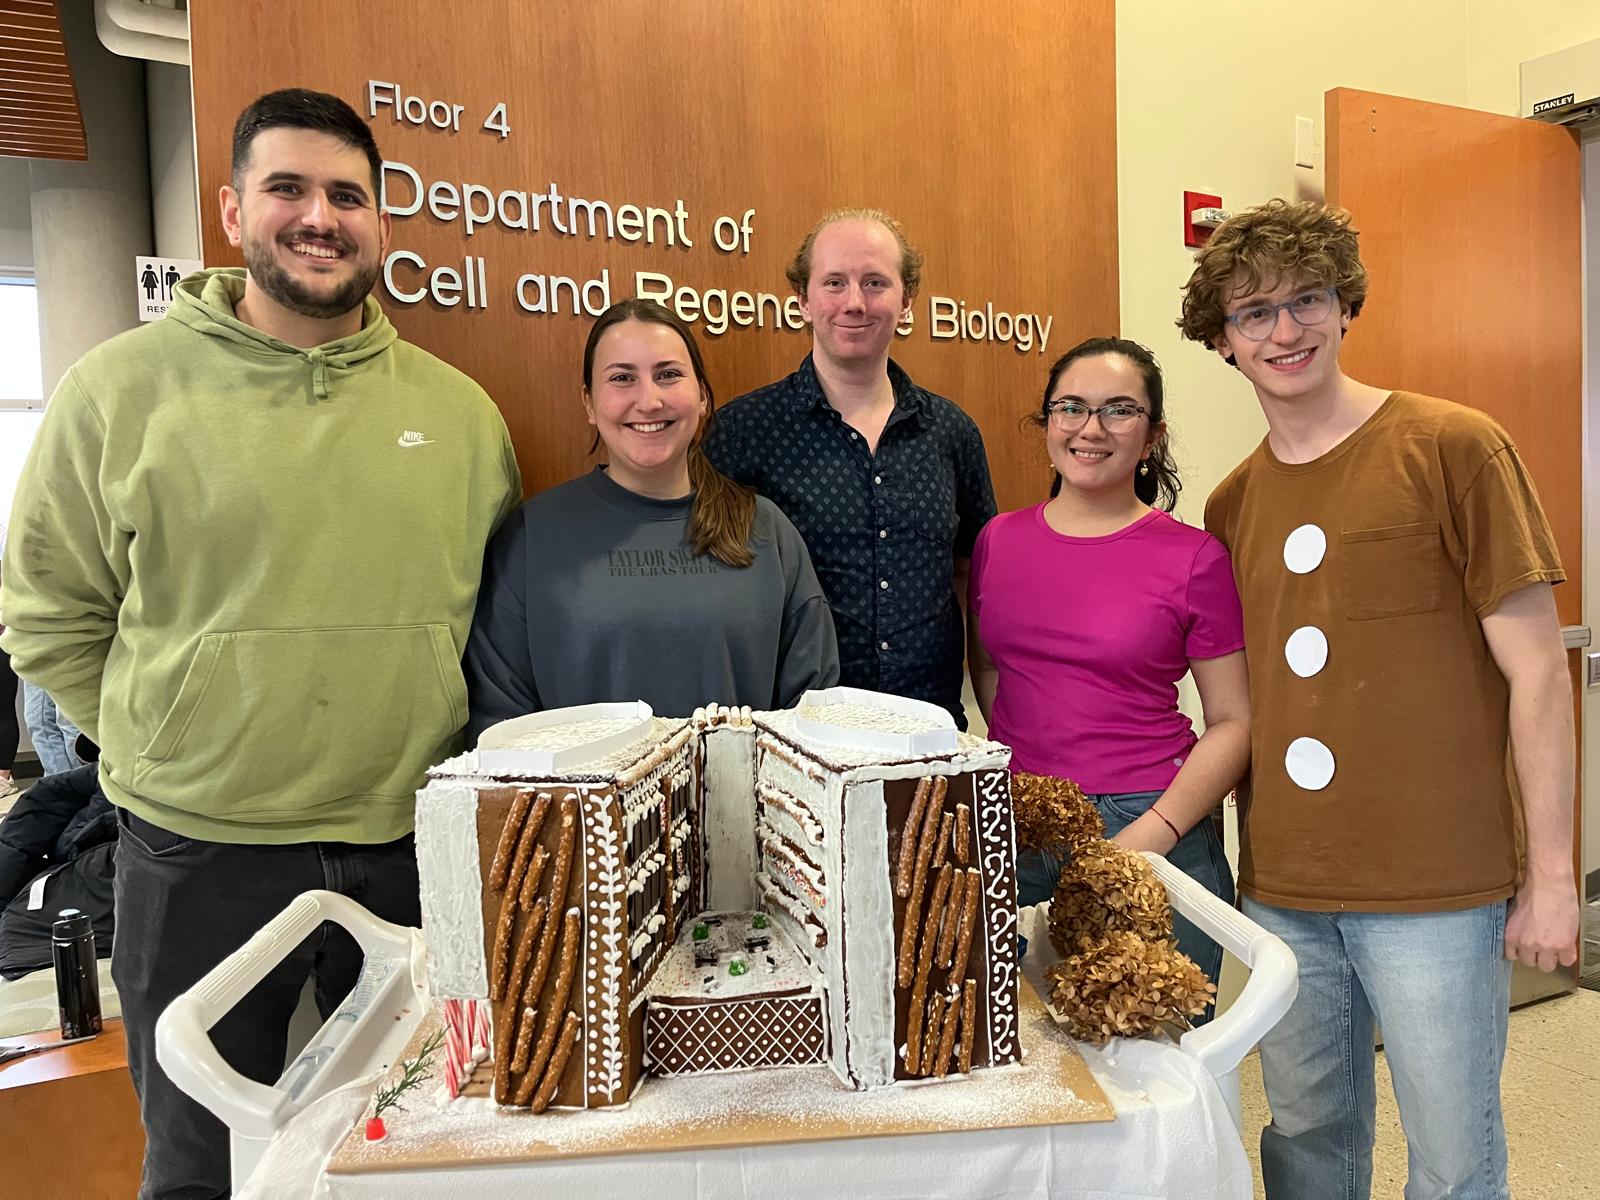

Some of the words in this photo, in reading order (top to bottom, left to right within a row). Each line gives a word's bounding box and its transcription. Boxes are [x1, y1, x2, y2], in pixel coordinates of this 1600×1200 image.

[368, 79, 465, 132] Floor
[484, 102, 511, 139] 4
[1534, 95, 1574, 113] STANLEY
[379, 160, 694, 248] Department
[714, 209, 756, 253] of
[383, 250, 488, 309] Cell
[516, 268, 612, 317] and
[931, 296, 1053, 353] Biology
[403, 429, 425, 442] NIKE
[607, 548, 666, 568] TAYLOR
[608, 567, 637, 577] THE
[640, 566, 677, 577] ERAS
[679, 563, 719, 575] TOUR
